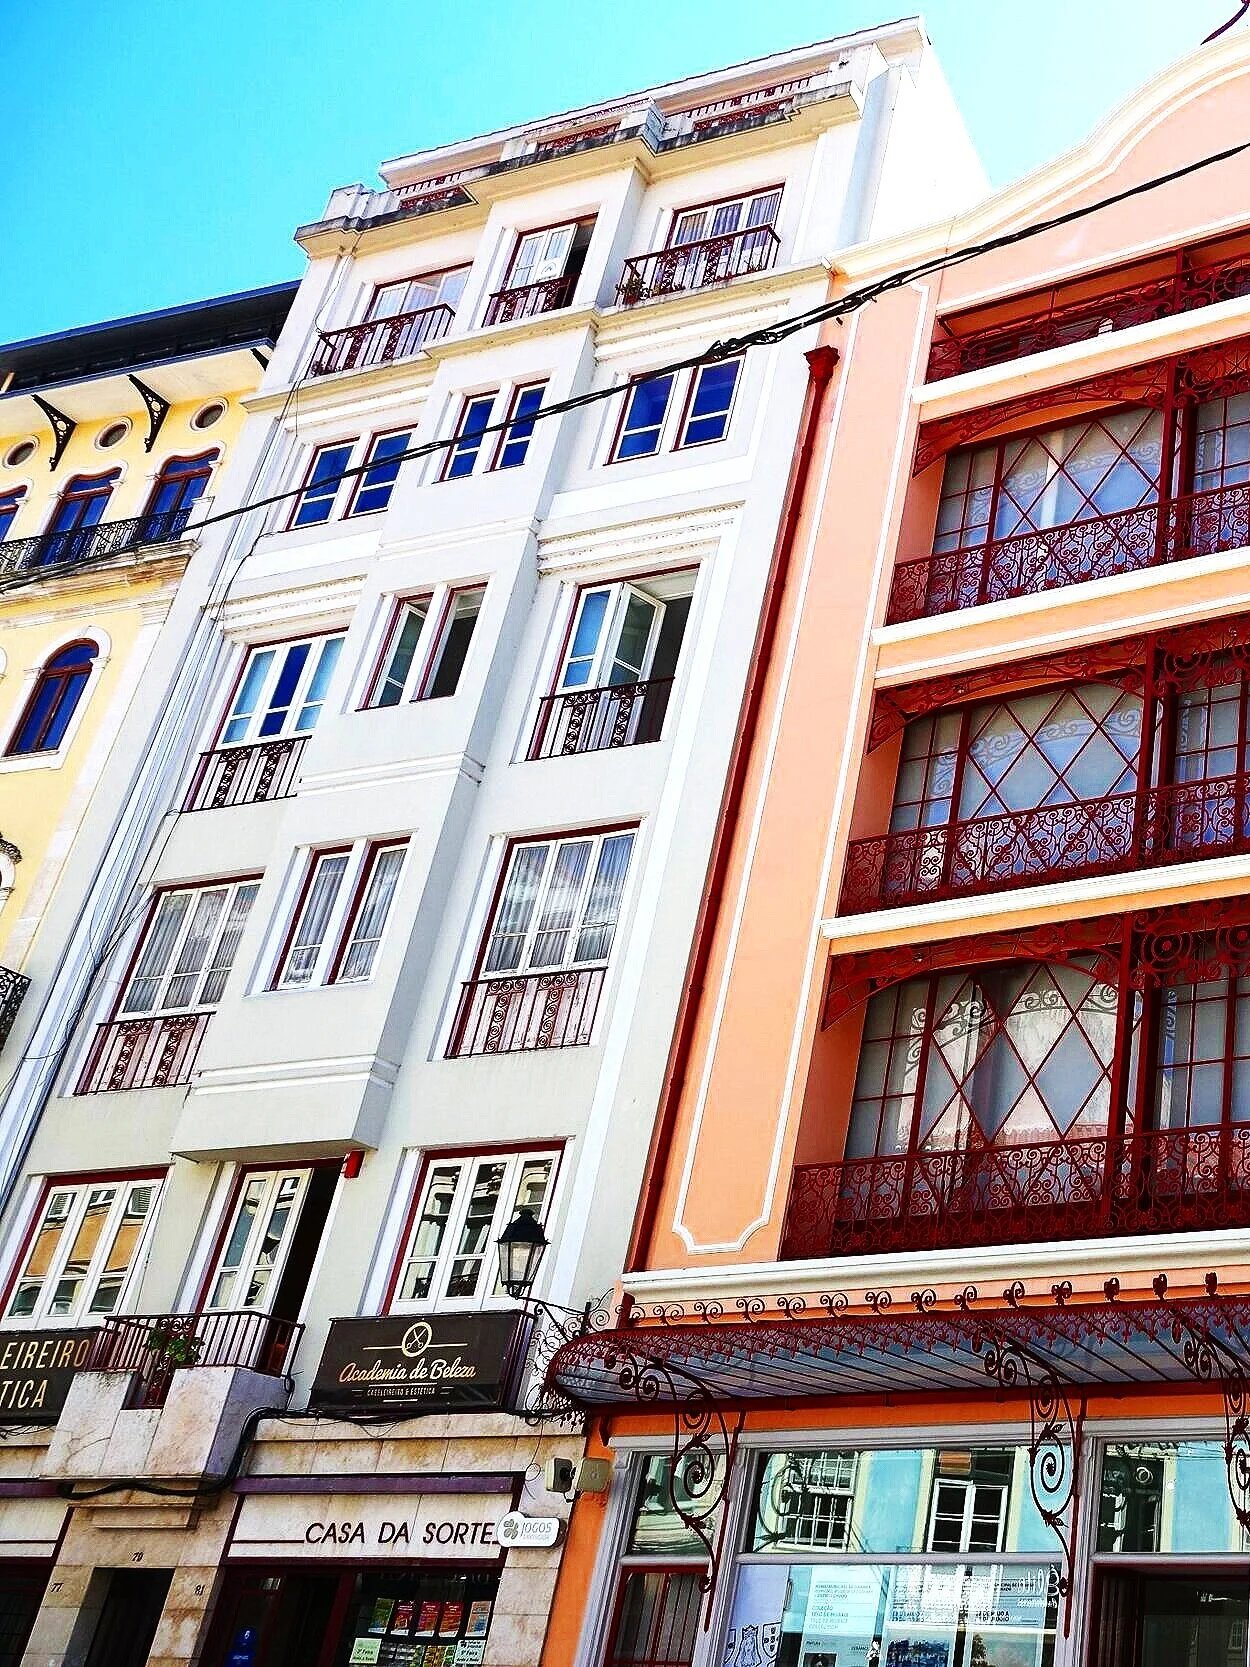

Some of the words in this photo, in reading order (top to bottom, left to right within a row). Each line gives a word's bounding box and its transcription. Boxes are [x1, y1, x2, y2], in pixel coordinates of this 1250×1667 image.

[0, 1339, 90, 1370] EIREIRO
[339, 1359, 407, 1382] Academia
[409, 1358, 429, 1380] de
[430, 1356, 476, 1380] Beleza
[0, 1379, 48, 1409] TICA
[305, 1522, 365, 1544] CASA
[378, 1522, 410, 1544] DA
[422, 1522, 496, 1545] SORTE
[521, 1522, 552, 1536] JOGOS
